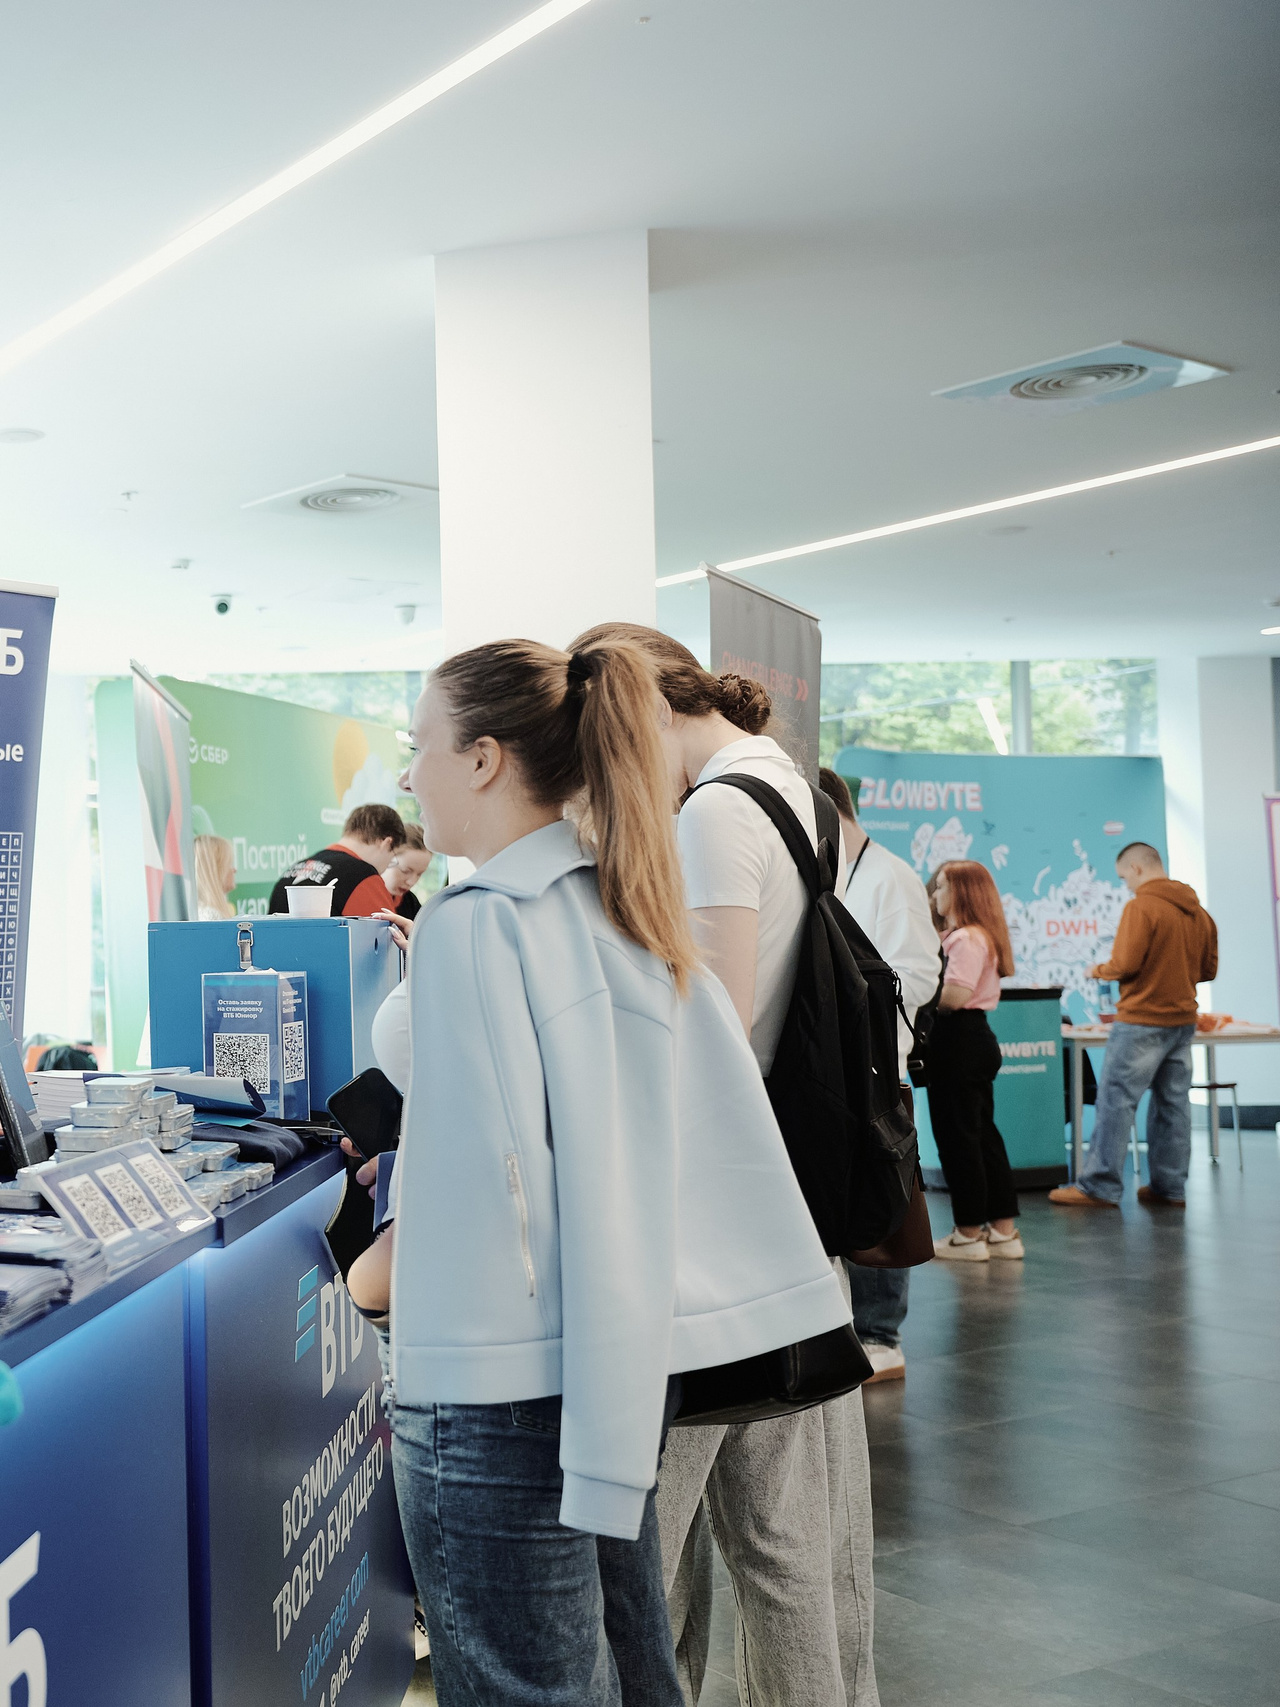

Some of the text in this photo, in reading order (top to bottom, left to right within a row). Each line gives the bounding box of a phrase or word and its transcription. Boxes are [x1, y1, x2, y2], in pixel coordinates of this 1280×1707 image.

[200, 744, 228, 765] СБЕР
[858, 776, 983, 811] GLOWBYTE
[233, 834, 308, 876] Построй
[1045, 918, 1099, 937] DWH
[999, 1040, 1056, 1058] OWBYTE
[282, 1381, 376, 1559] ВОЗМОЖНОСТИ
[273, 1436, 384, 1652] ТВОЕГО БУДУЩЕГО
